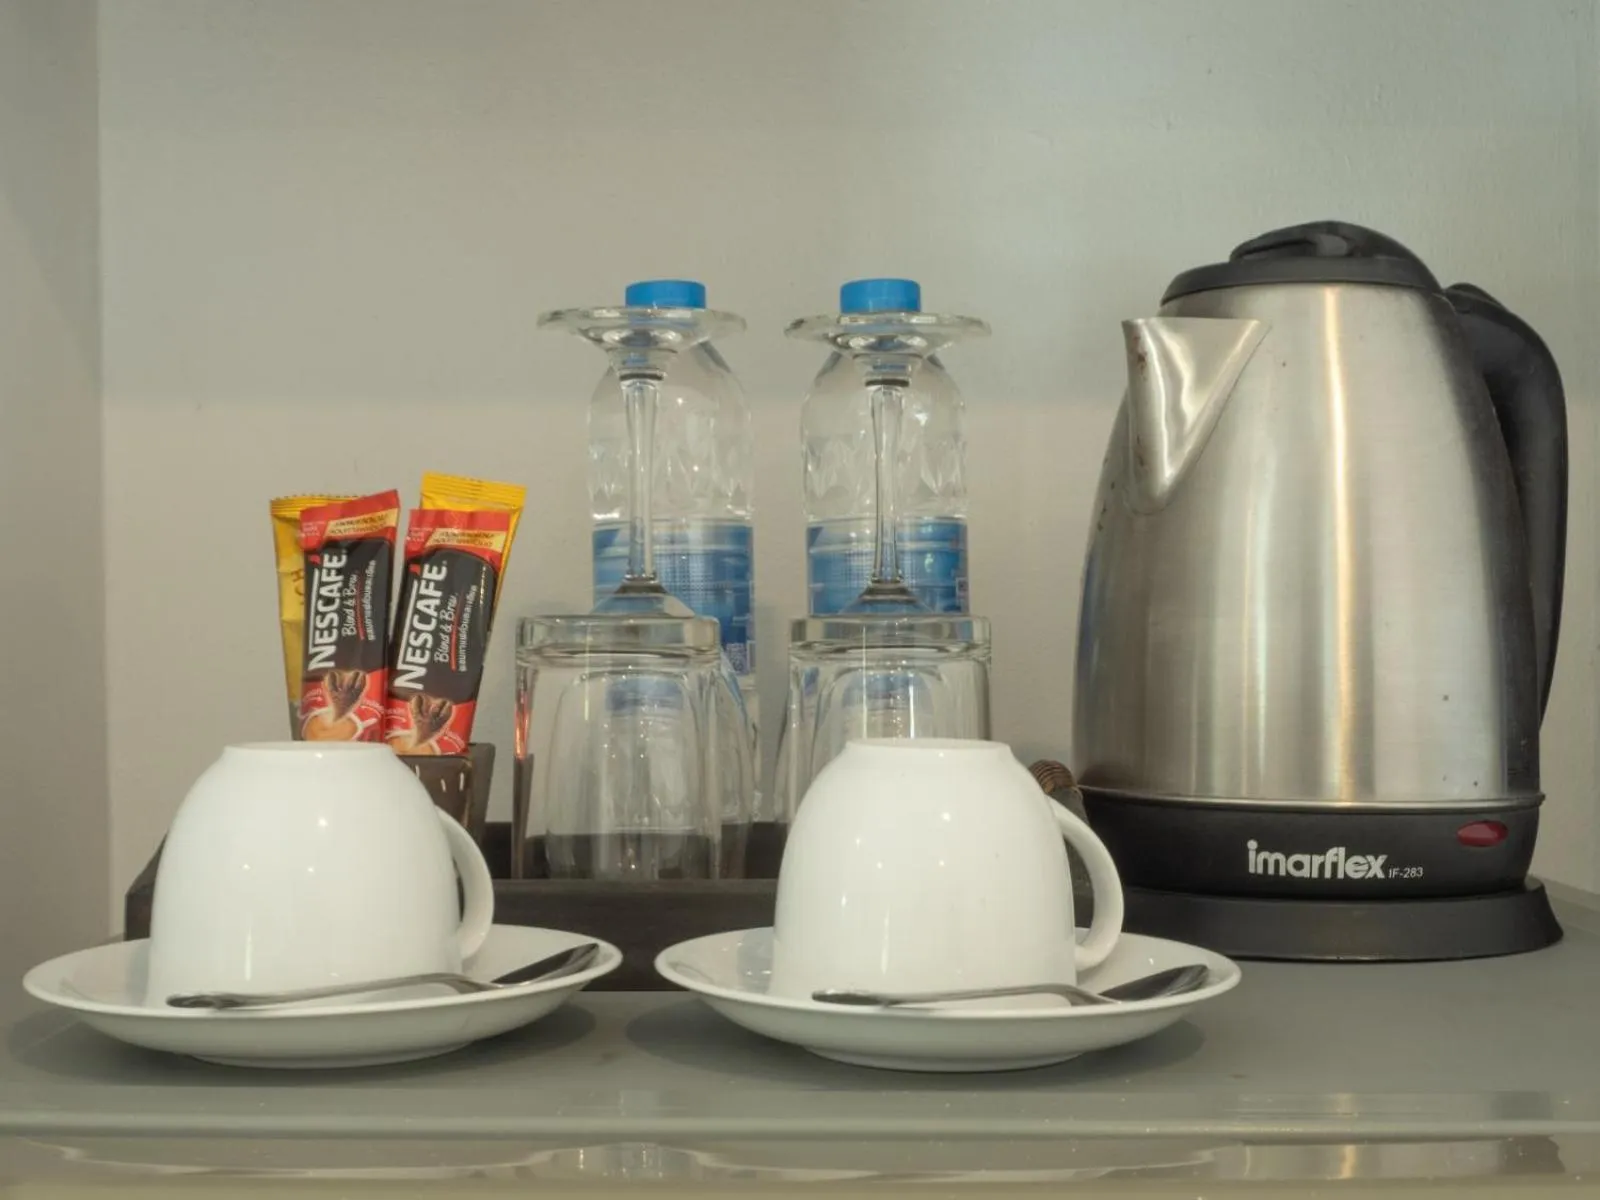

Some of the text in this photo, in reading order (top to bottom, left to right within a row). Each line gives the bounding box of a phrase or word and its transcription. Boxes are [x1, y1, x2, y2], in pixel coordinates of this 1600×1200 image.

[342, 574, 358, 598] Brew
[440, 595, 458, 620] Brew
[341, 610, 357, 637] Blend
[434, 632, 450, 663] Blend
[1247, 839, 1423, 879] imarflex IF-283
